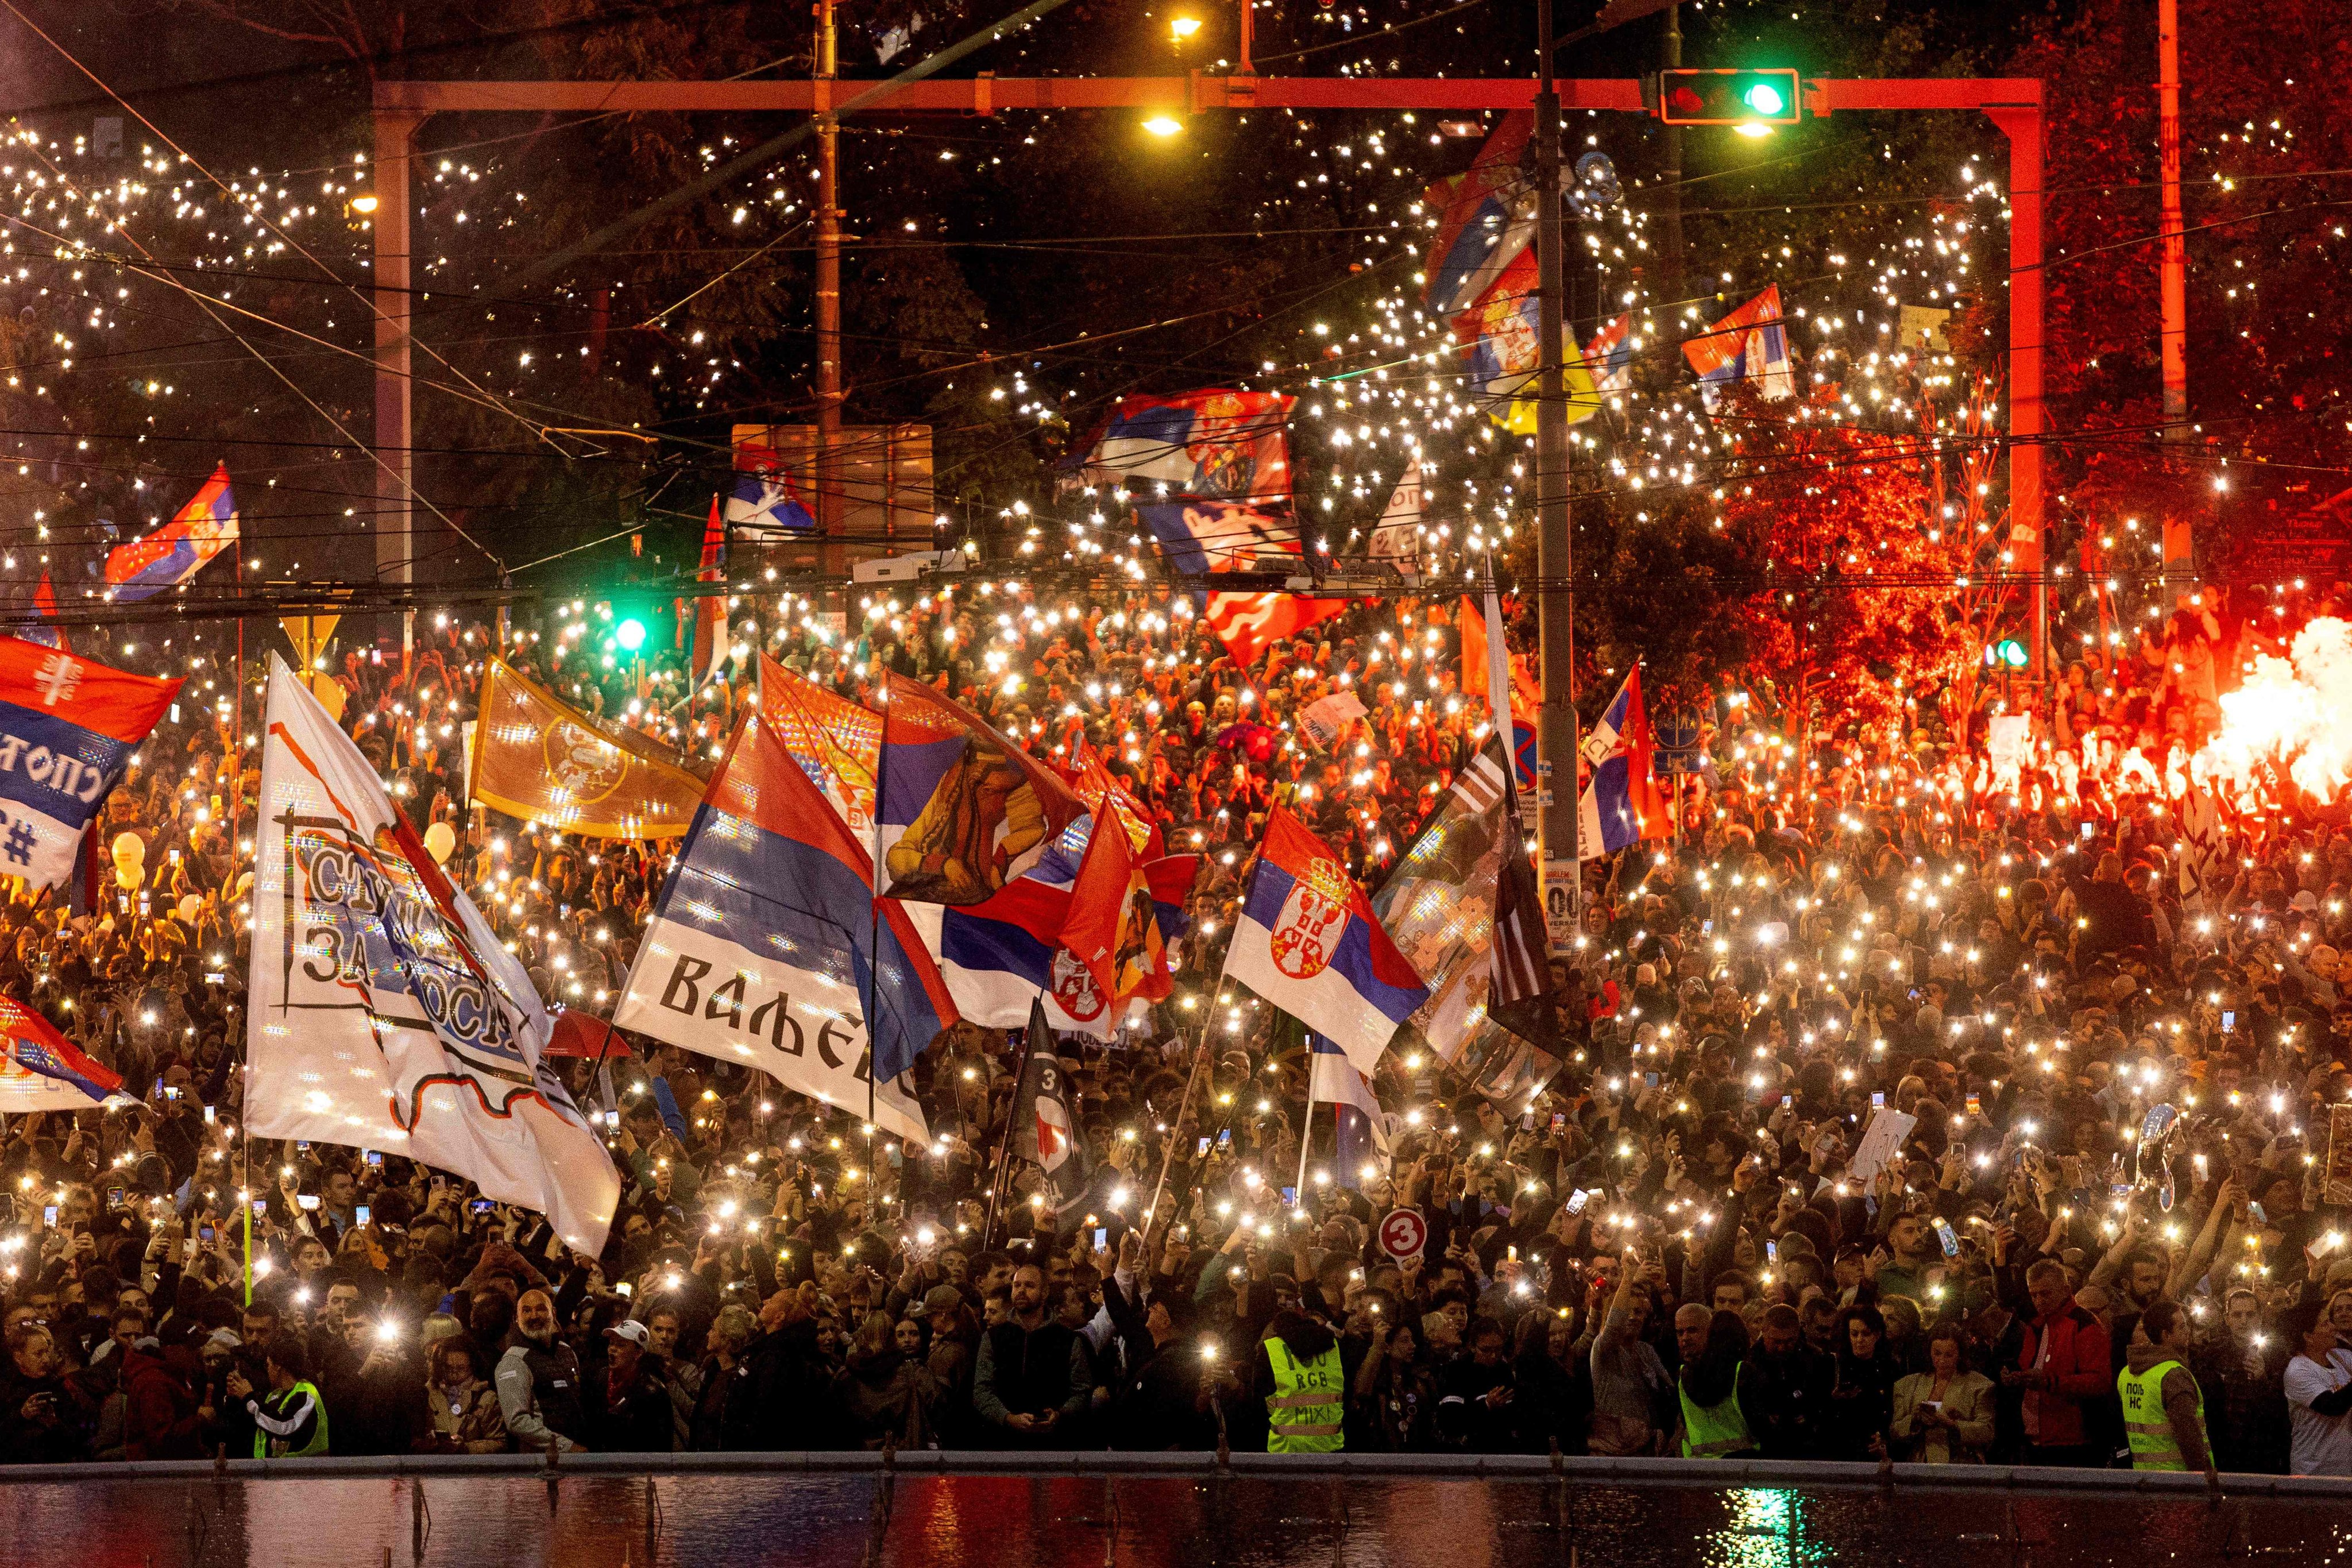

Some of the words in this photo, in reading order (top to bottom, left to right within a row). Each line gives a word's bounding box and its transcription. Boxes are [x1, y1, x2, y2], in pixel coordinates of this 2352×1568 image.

[302, 926, 372, 987] ЗА
[659, 953, 917, 1099] ВАЉЕ
[1041, 1068, 1057, 1090] 3
[1389, 1217, 1418, 1251] 3
[1296, 1371, 1328, 1389] RGB
[2129, 1397, 2142, 1409] НС
